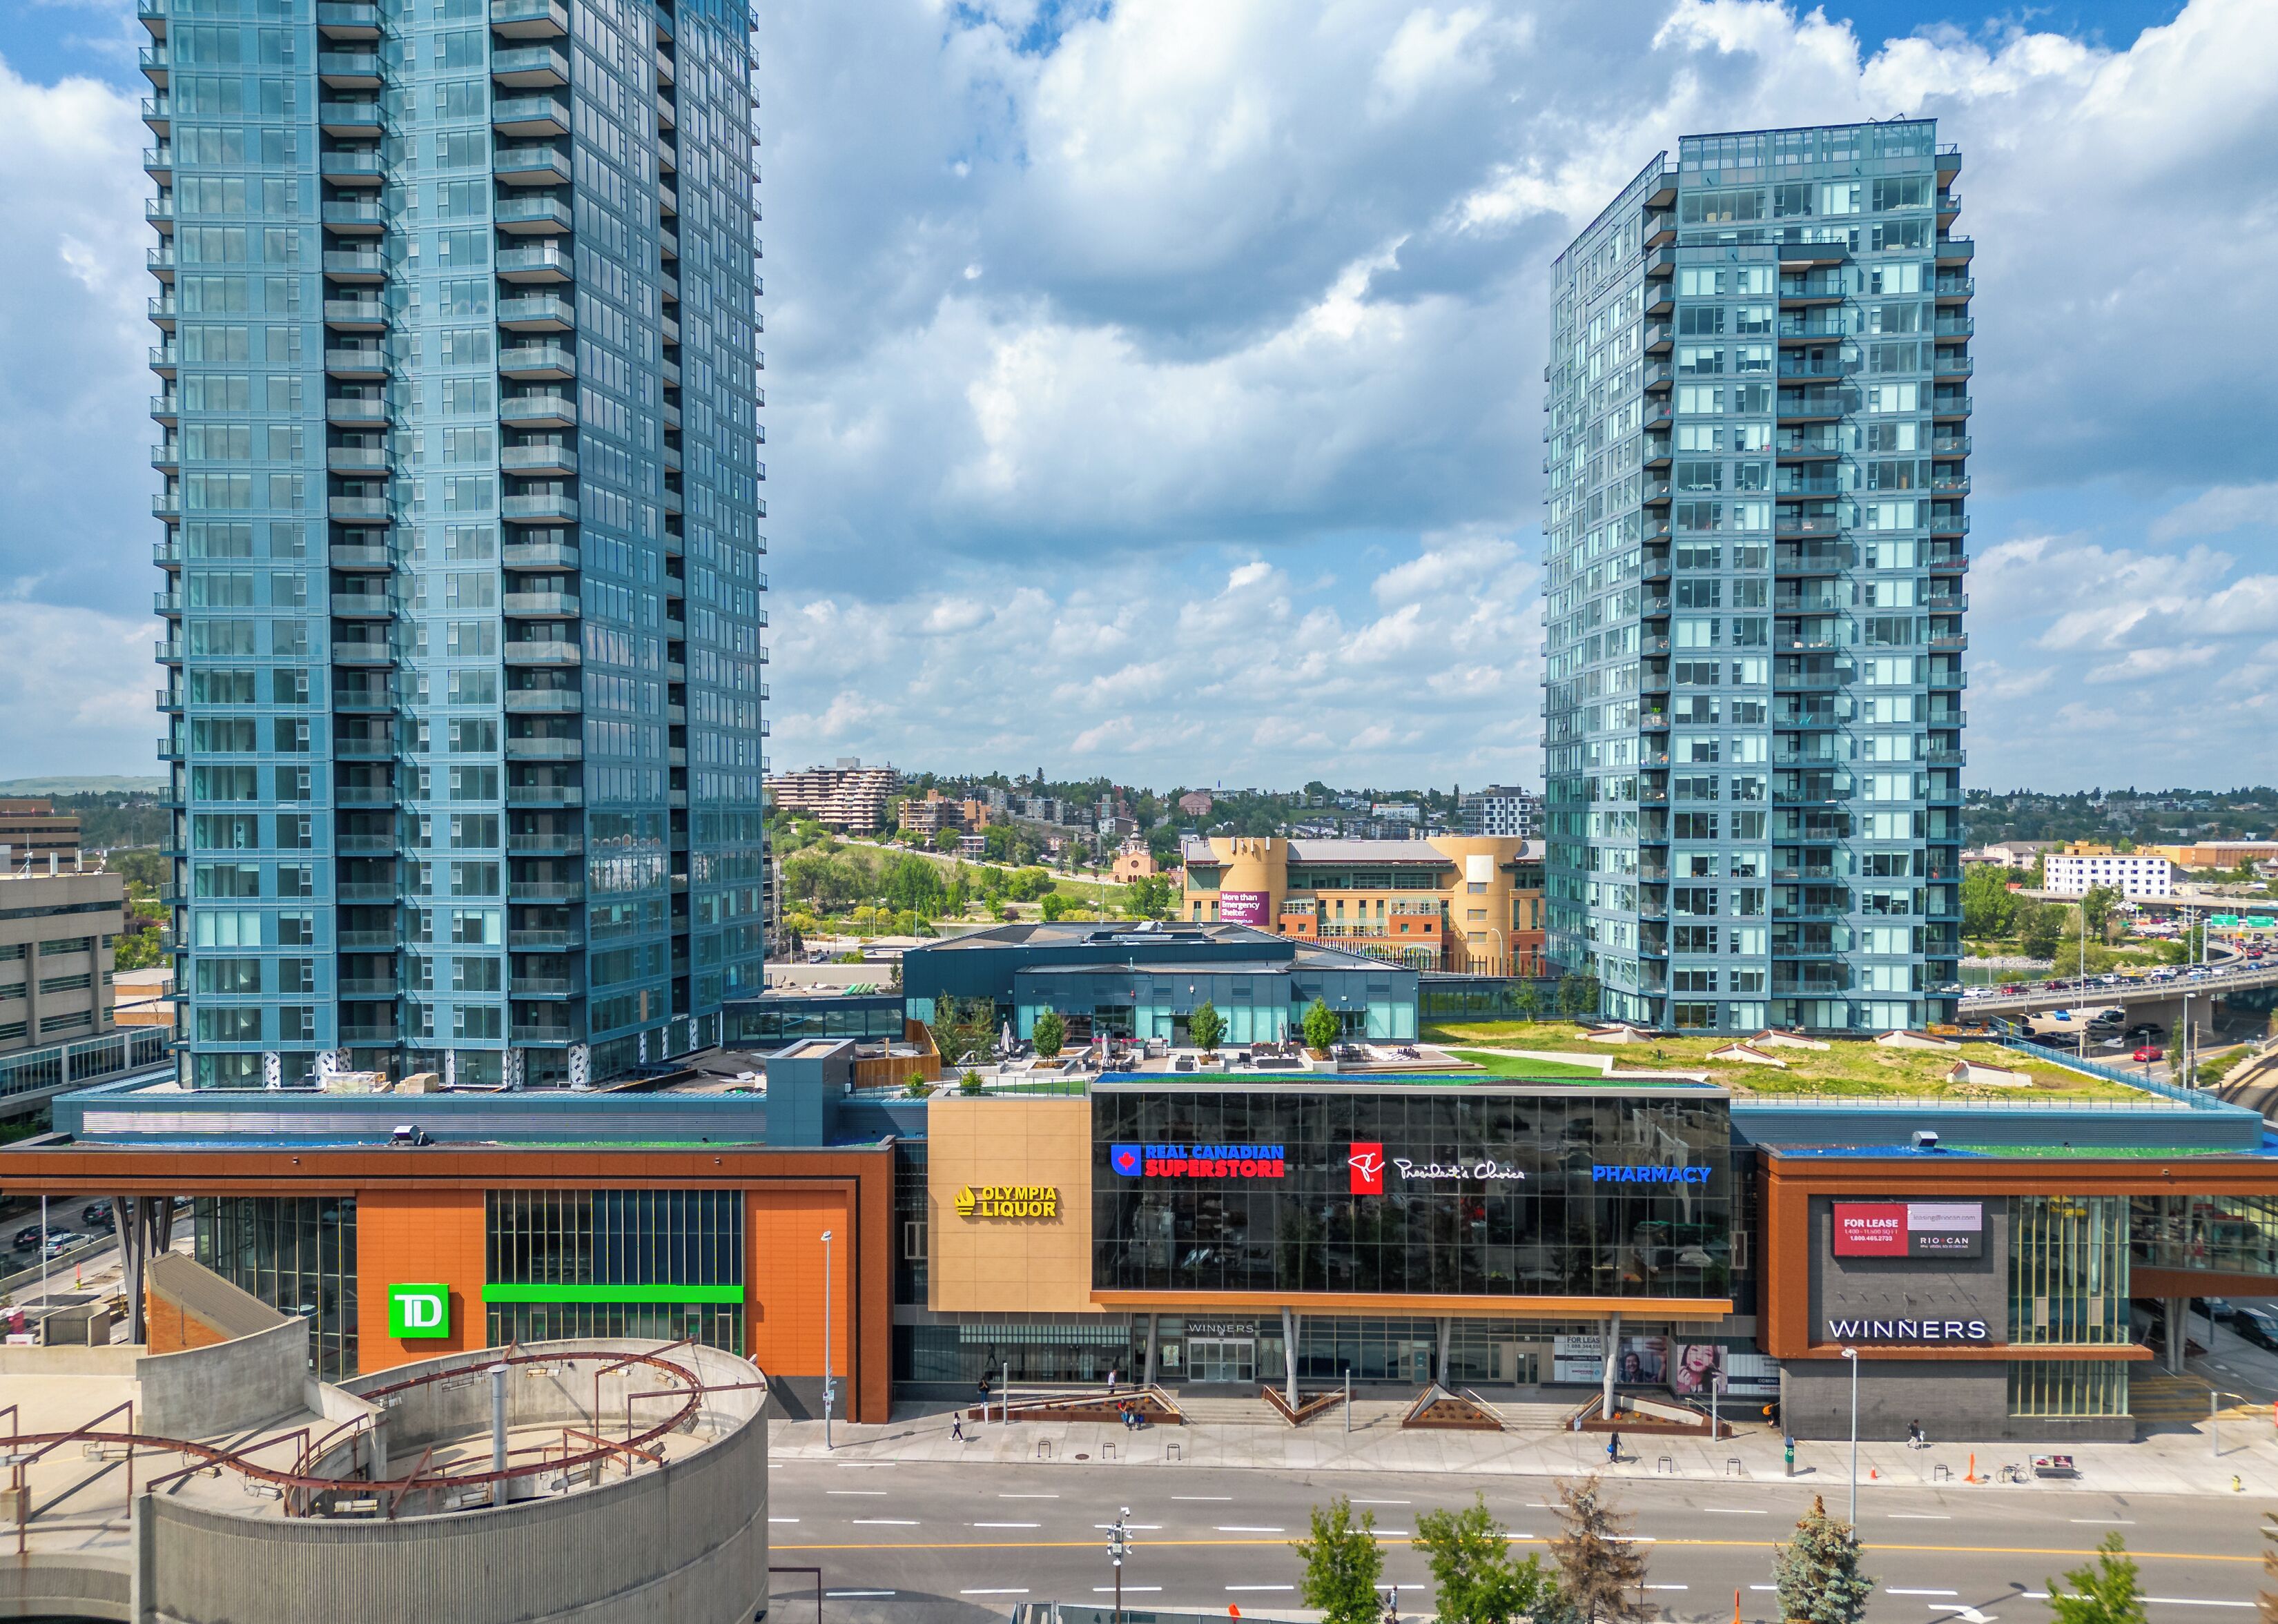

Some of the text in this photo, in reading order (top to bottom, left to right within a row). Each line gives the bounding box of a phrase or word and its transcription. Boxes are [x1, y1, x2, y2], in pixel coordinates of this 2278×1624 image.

[1221, 908, 1247, 917] Shelter.
[1222, 901, 1260, 910] Emergency
[1145, 1145, 1284, 1159] REAL CANADIAN
[1144, 1159, 1284, 1177] SUPERSTORE
[1393, 1158, 1526, 1180] President's Choice
[1593, 1165, 1712, 1183] PHARMACY
[982, 1186, 1057, 1200] OLYMPIA
[982, 1201, 1056, 1217] LIQUOR
[1844, 1219, 1898, 1227] FOR LEASE
[394, 1294, 442, 1327] TD
[1189, 1324, 1254, 1333] WINNERS
[1829, 1320, 1986, 1339] WINNERS
